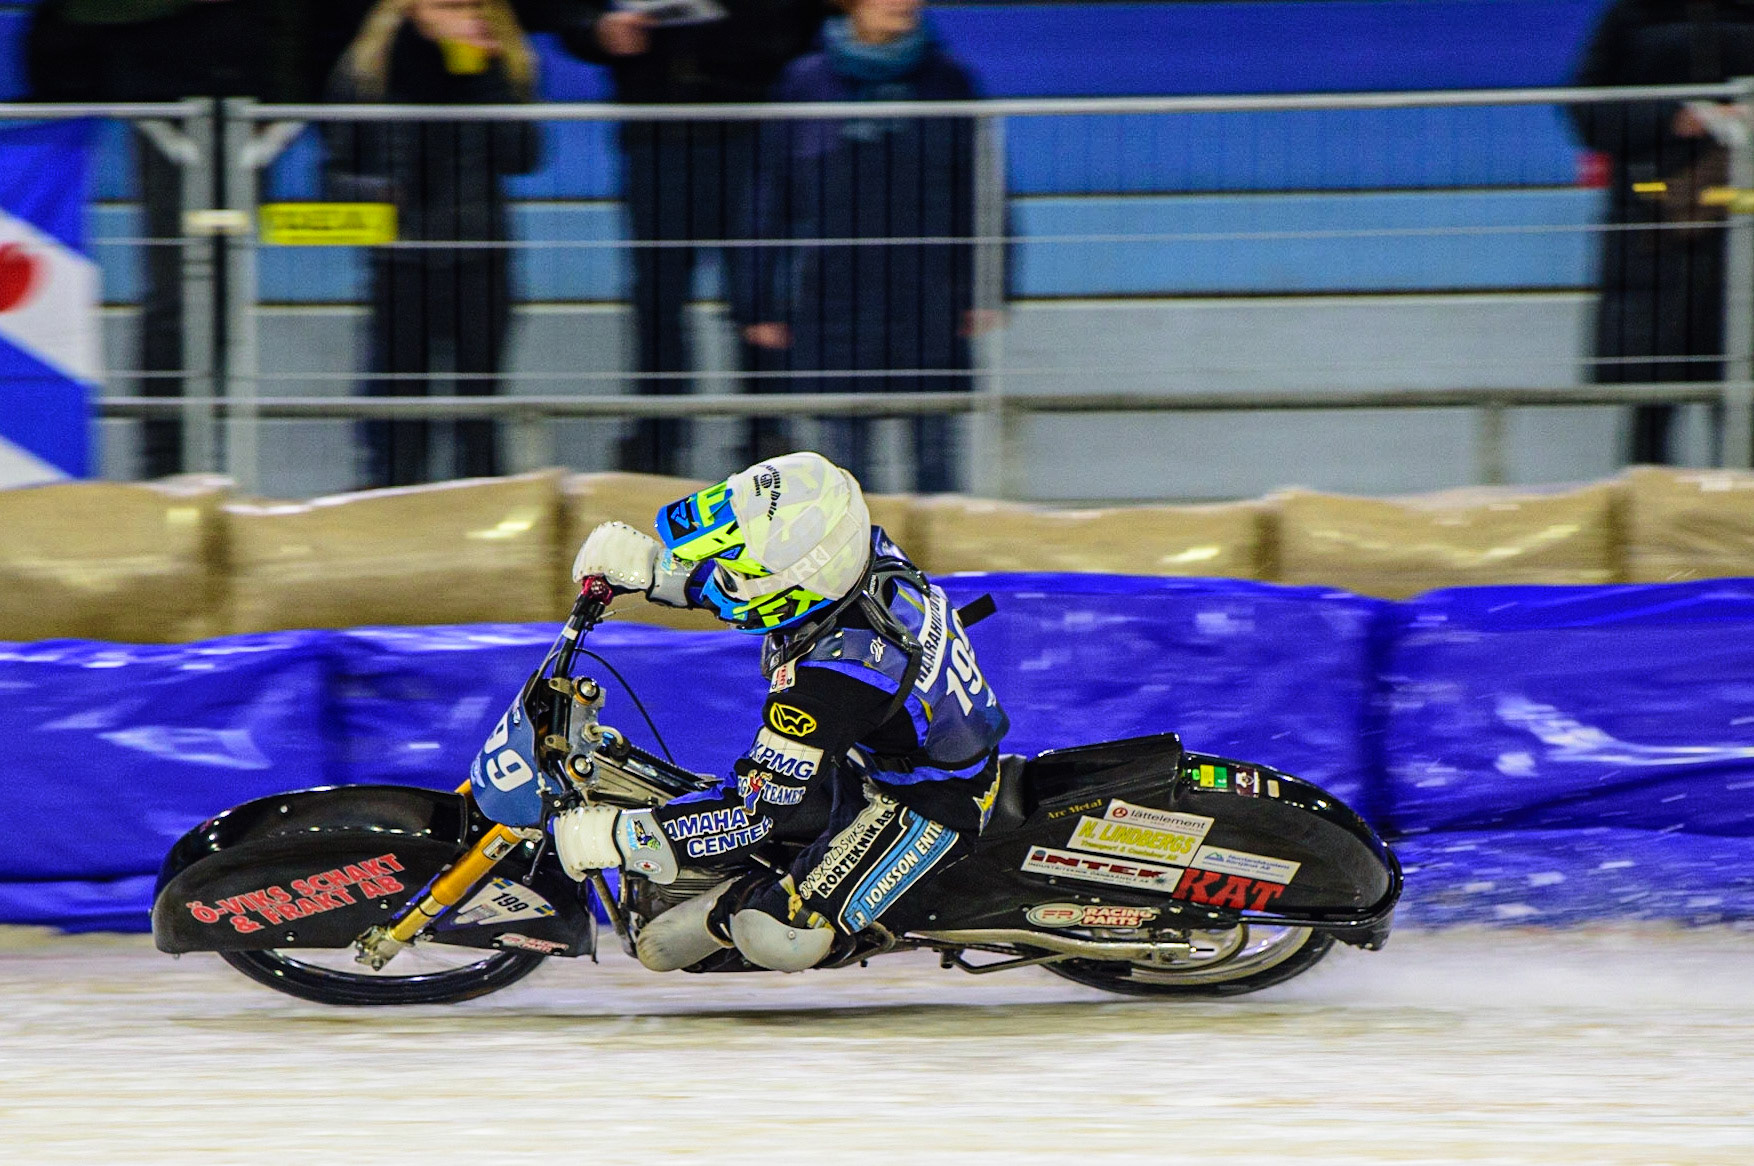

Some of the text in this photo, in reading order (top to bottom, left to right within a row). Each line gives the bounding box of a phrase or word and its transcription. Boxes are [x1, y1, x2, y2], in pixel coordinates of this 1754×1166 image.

[749, 741, 816, 780] KPMG
[876, 809, 894, 826] AB
[1068, 798, 1103, 813] Metal
[1130, 808, 1206, 829] lättelement
[662, 807, 748, 840] AMAHA
[1099, 823, 1196, 854] LINDBERGS
[186, 853, 405, 923] Ö-VIKS SCHAKT
[1172, 867, 1286, 912] KAT
[230, 875, 404, 934] & FRAKT AB
[491, 892, 529, 913] 199
[1084, 906, 1154, 919] RACING
[1082, 916, 1140, 927] PARTS
